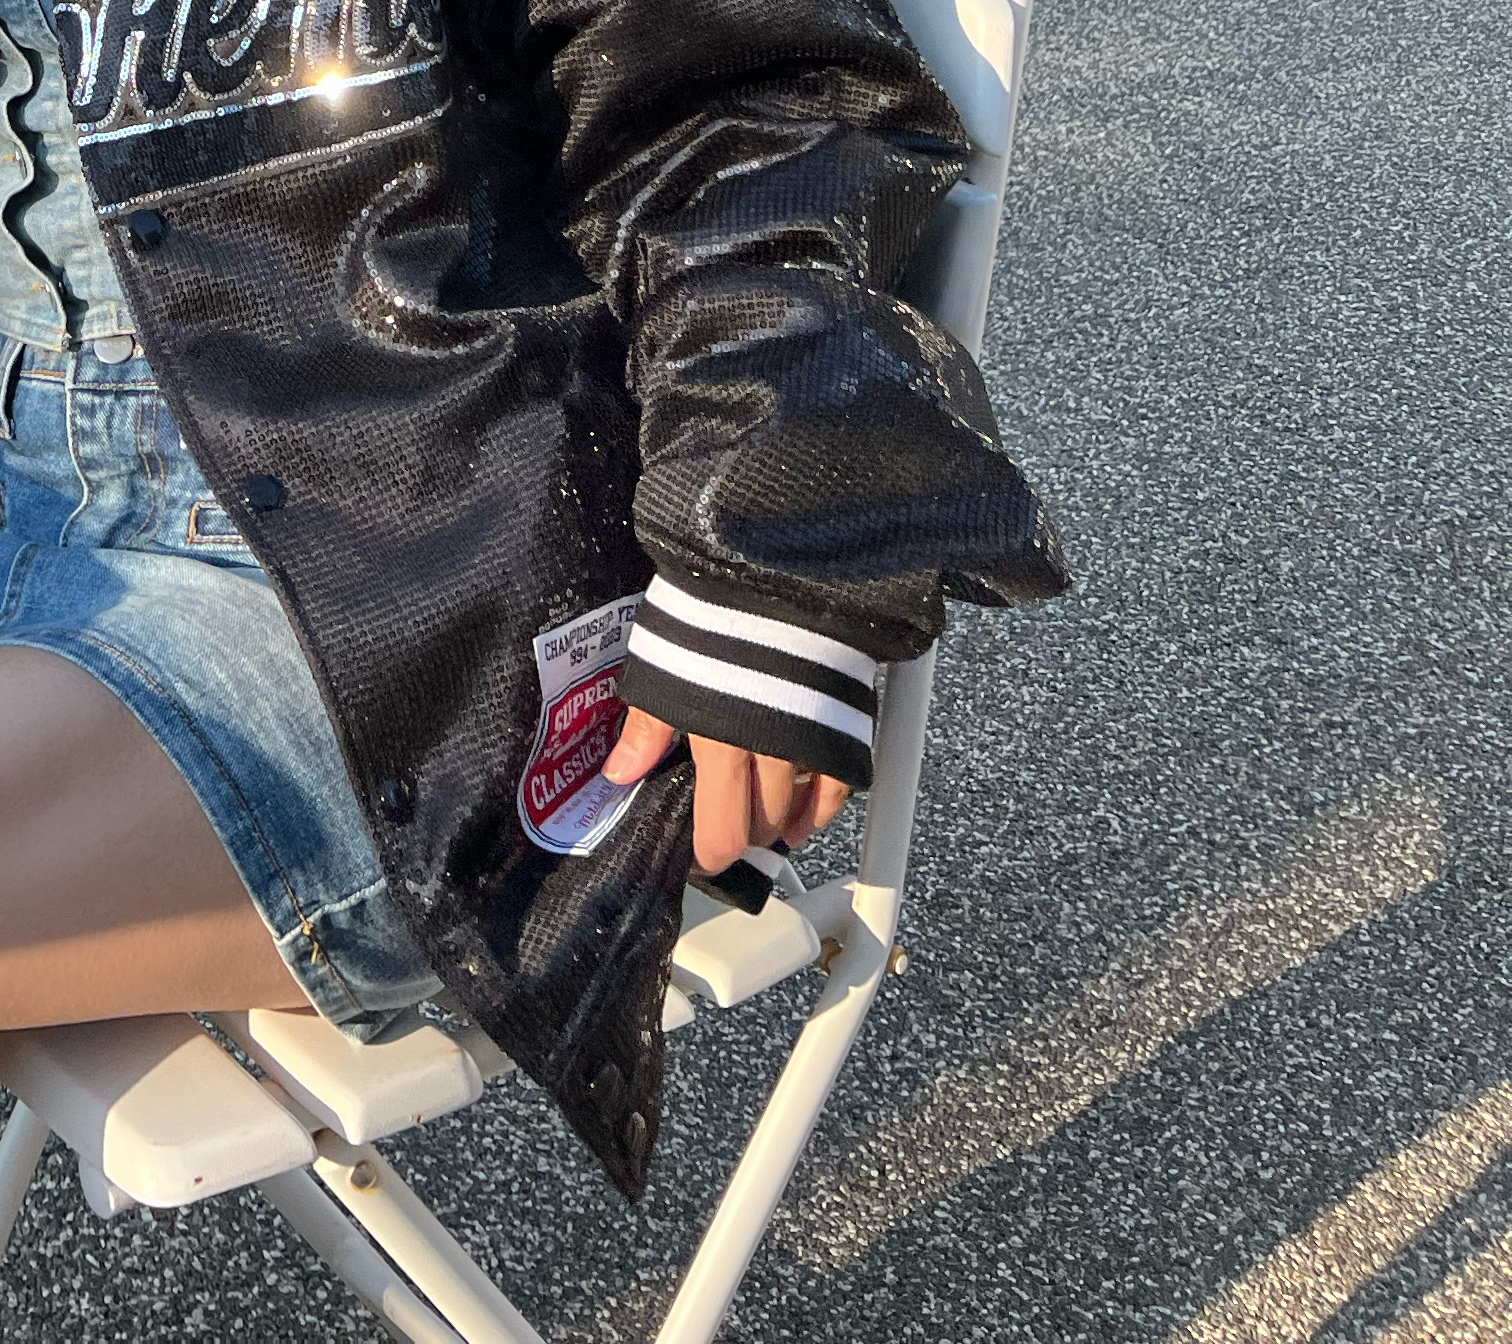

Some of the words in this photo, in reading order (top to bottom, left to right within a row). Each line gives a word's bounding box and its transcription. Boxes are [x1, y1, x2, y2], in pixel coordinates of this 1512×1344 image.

[543, 610, 614, 662] CHAMPIONSHIP
[617, 603, 640, 624] YE
[530, 734, 607, 811] CLASSICS
